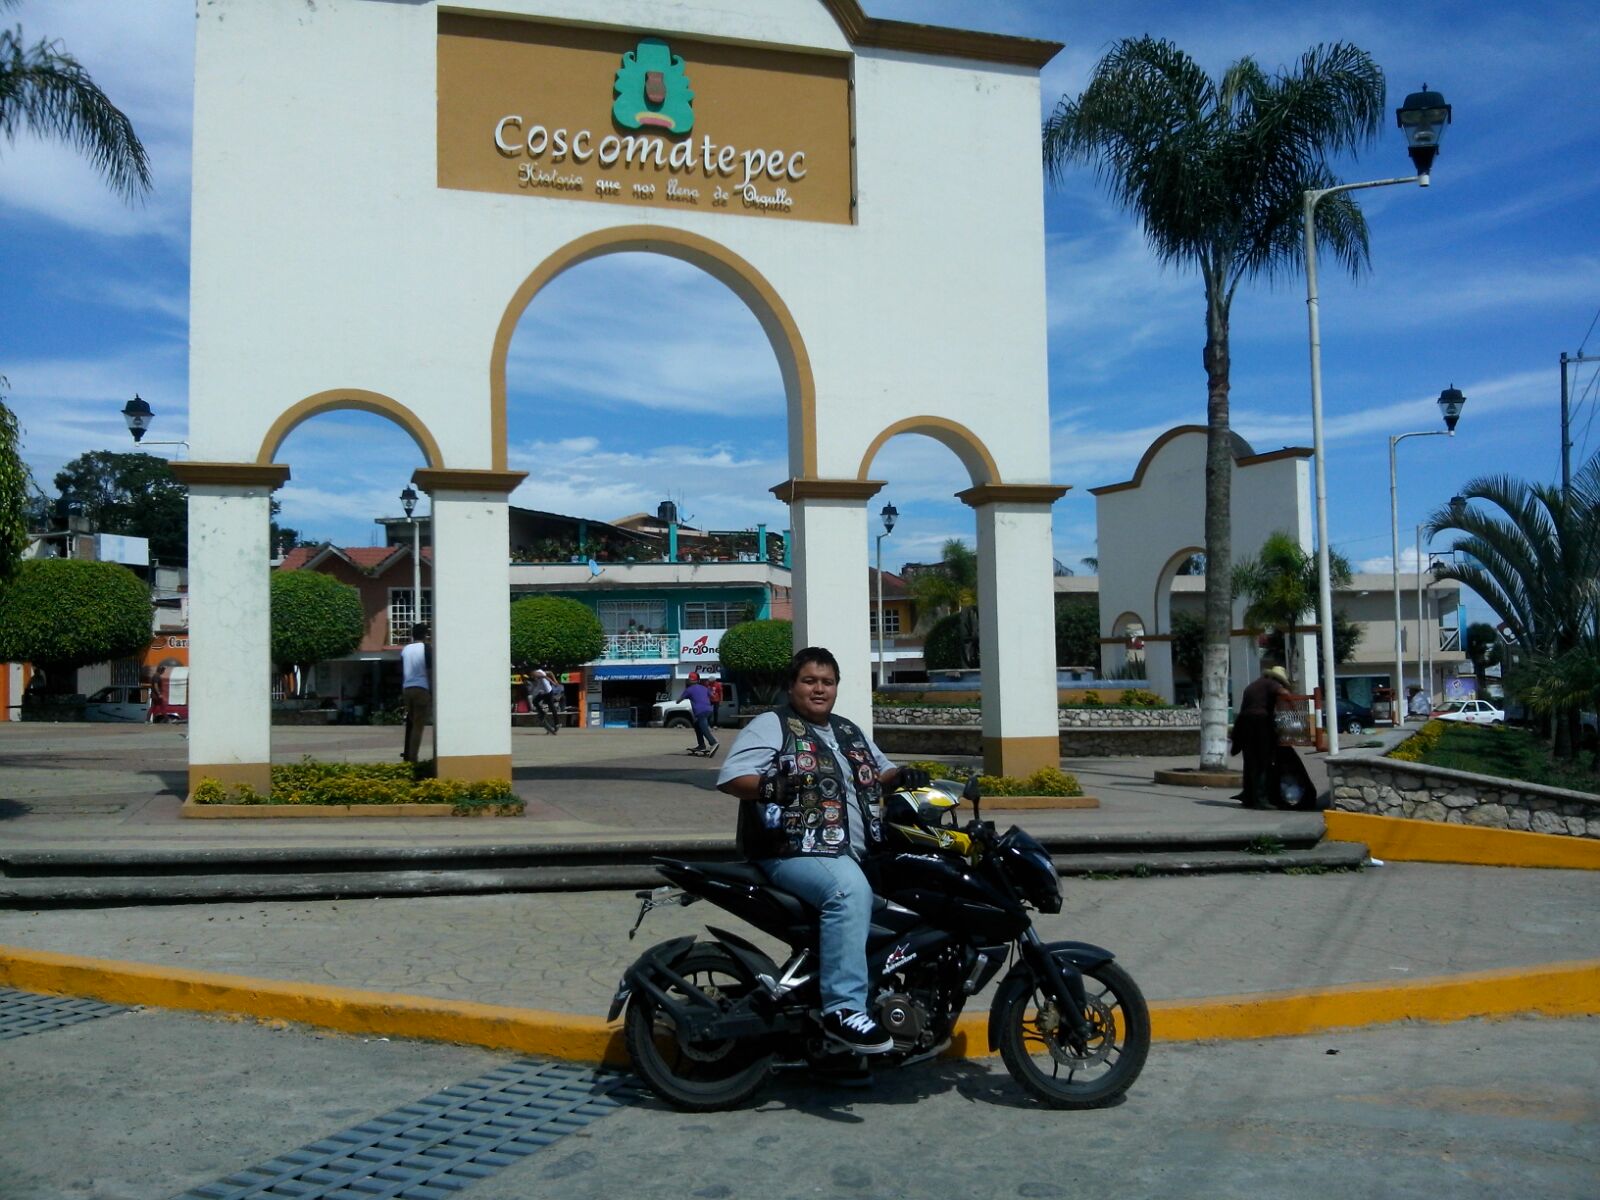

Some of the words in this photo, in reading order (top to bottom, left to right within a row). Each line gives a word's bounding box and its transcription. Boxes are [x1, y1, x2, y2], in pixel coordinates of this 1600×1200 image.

[494, 115, 807, 190] Coscomatepec
[519, 161, 583, 183] Historia
[596, 178, 621, 191] que
[633, 182, 656, 193] nos
[667, 178, 700, 197] llena
[713, 186, 730, 200] de
